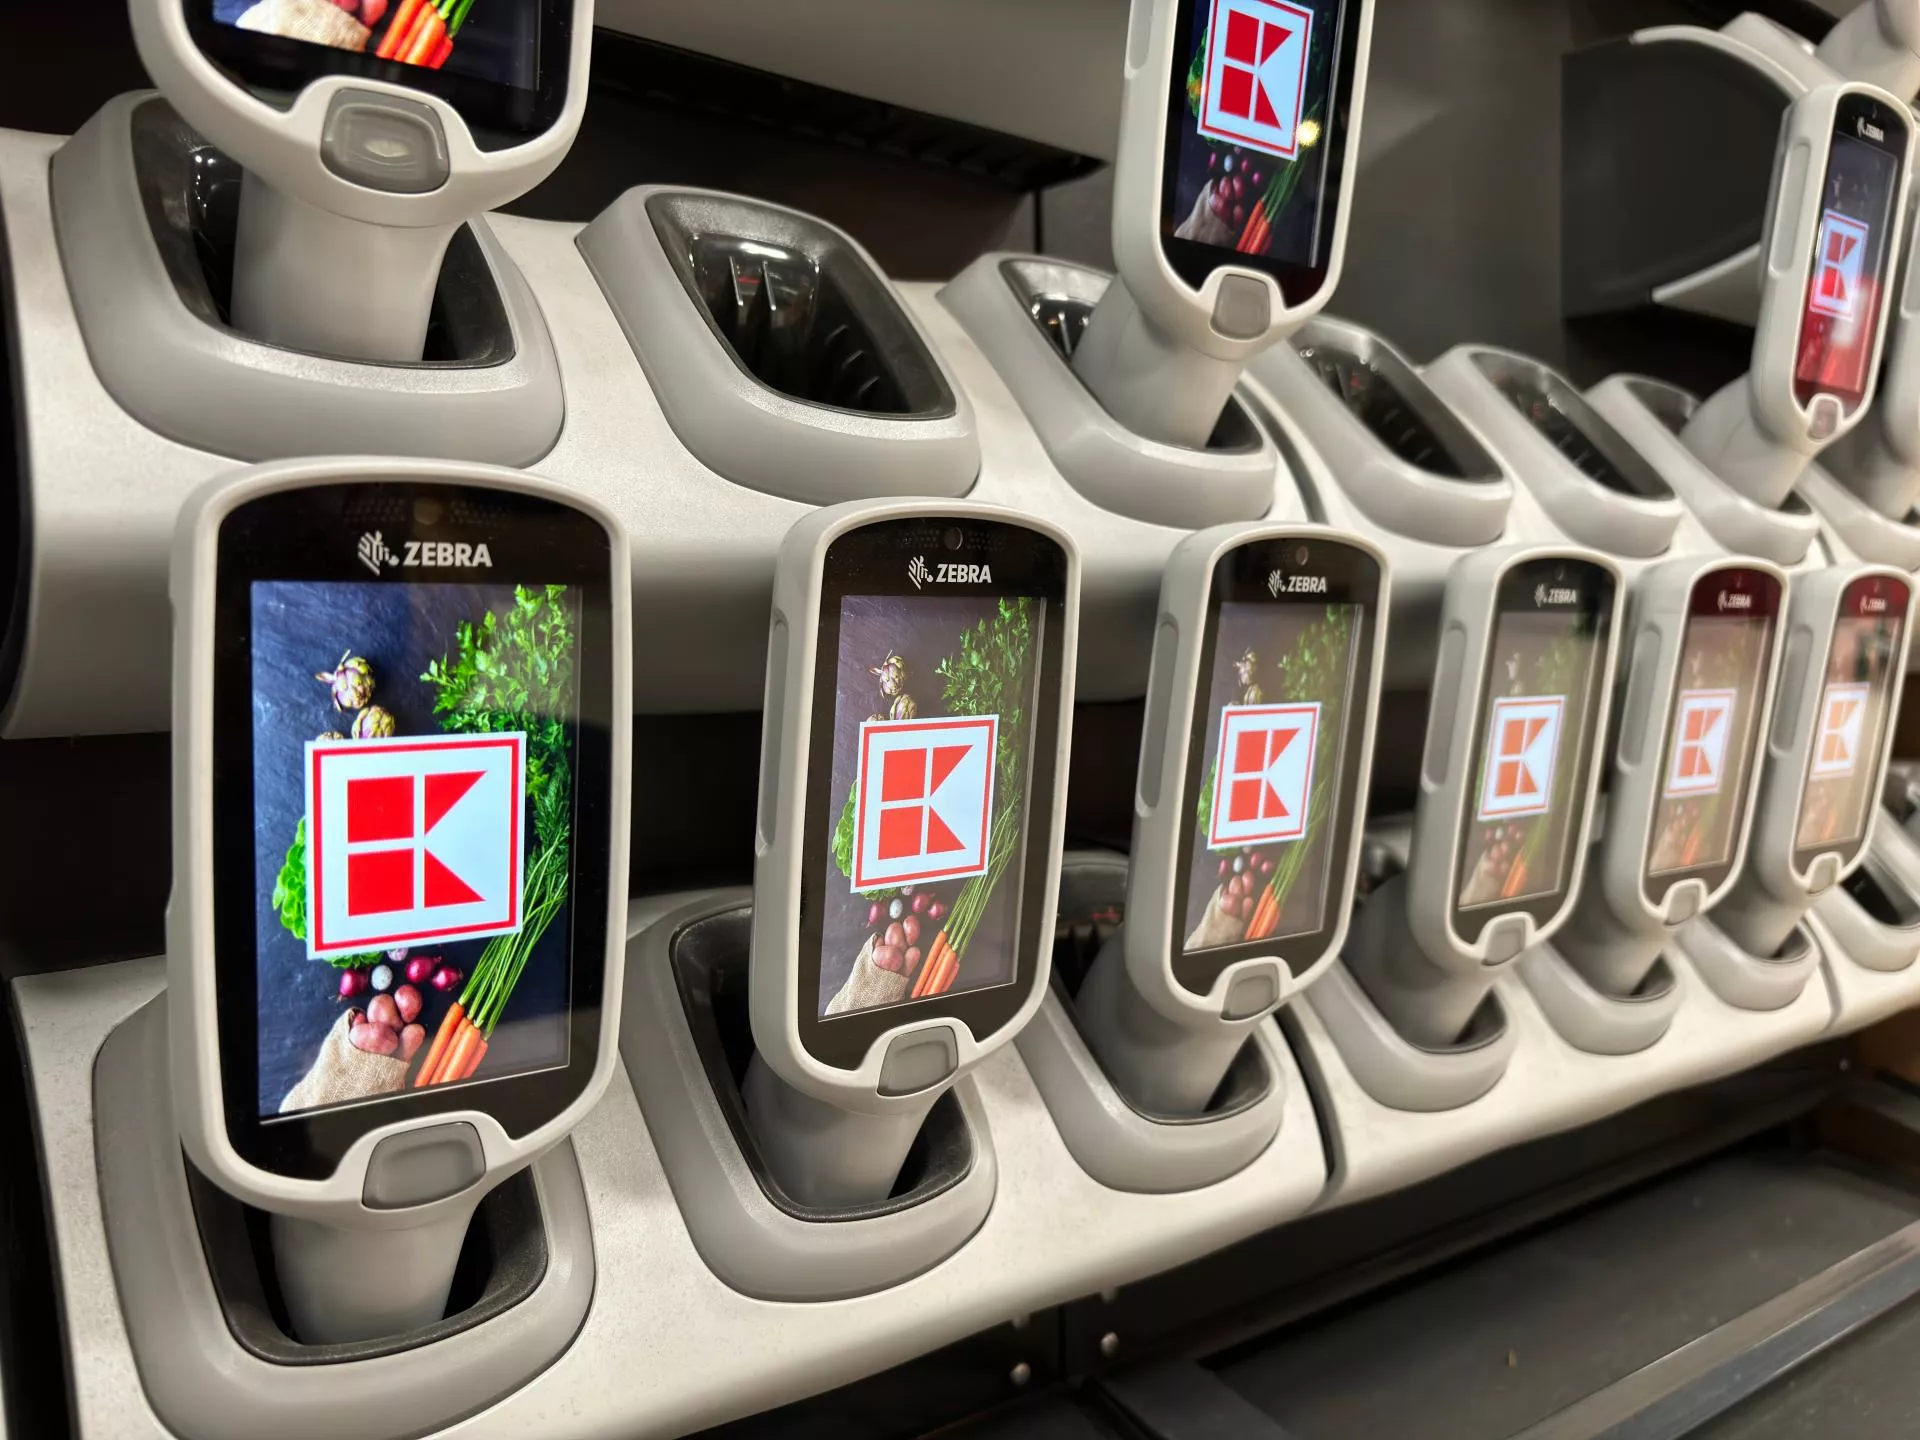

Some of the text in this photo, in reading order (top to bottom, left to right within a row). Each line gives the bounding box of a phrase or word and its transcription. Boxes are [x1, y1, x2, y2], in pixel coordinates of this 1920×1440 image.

[403, 541, 493, 568] ZEBRA
[936, 563, 992, 584] ZEBRA
[1287, 575, 1327, 593] ZEBRA
[1548, 588, 1577, 604] ZEBRA
